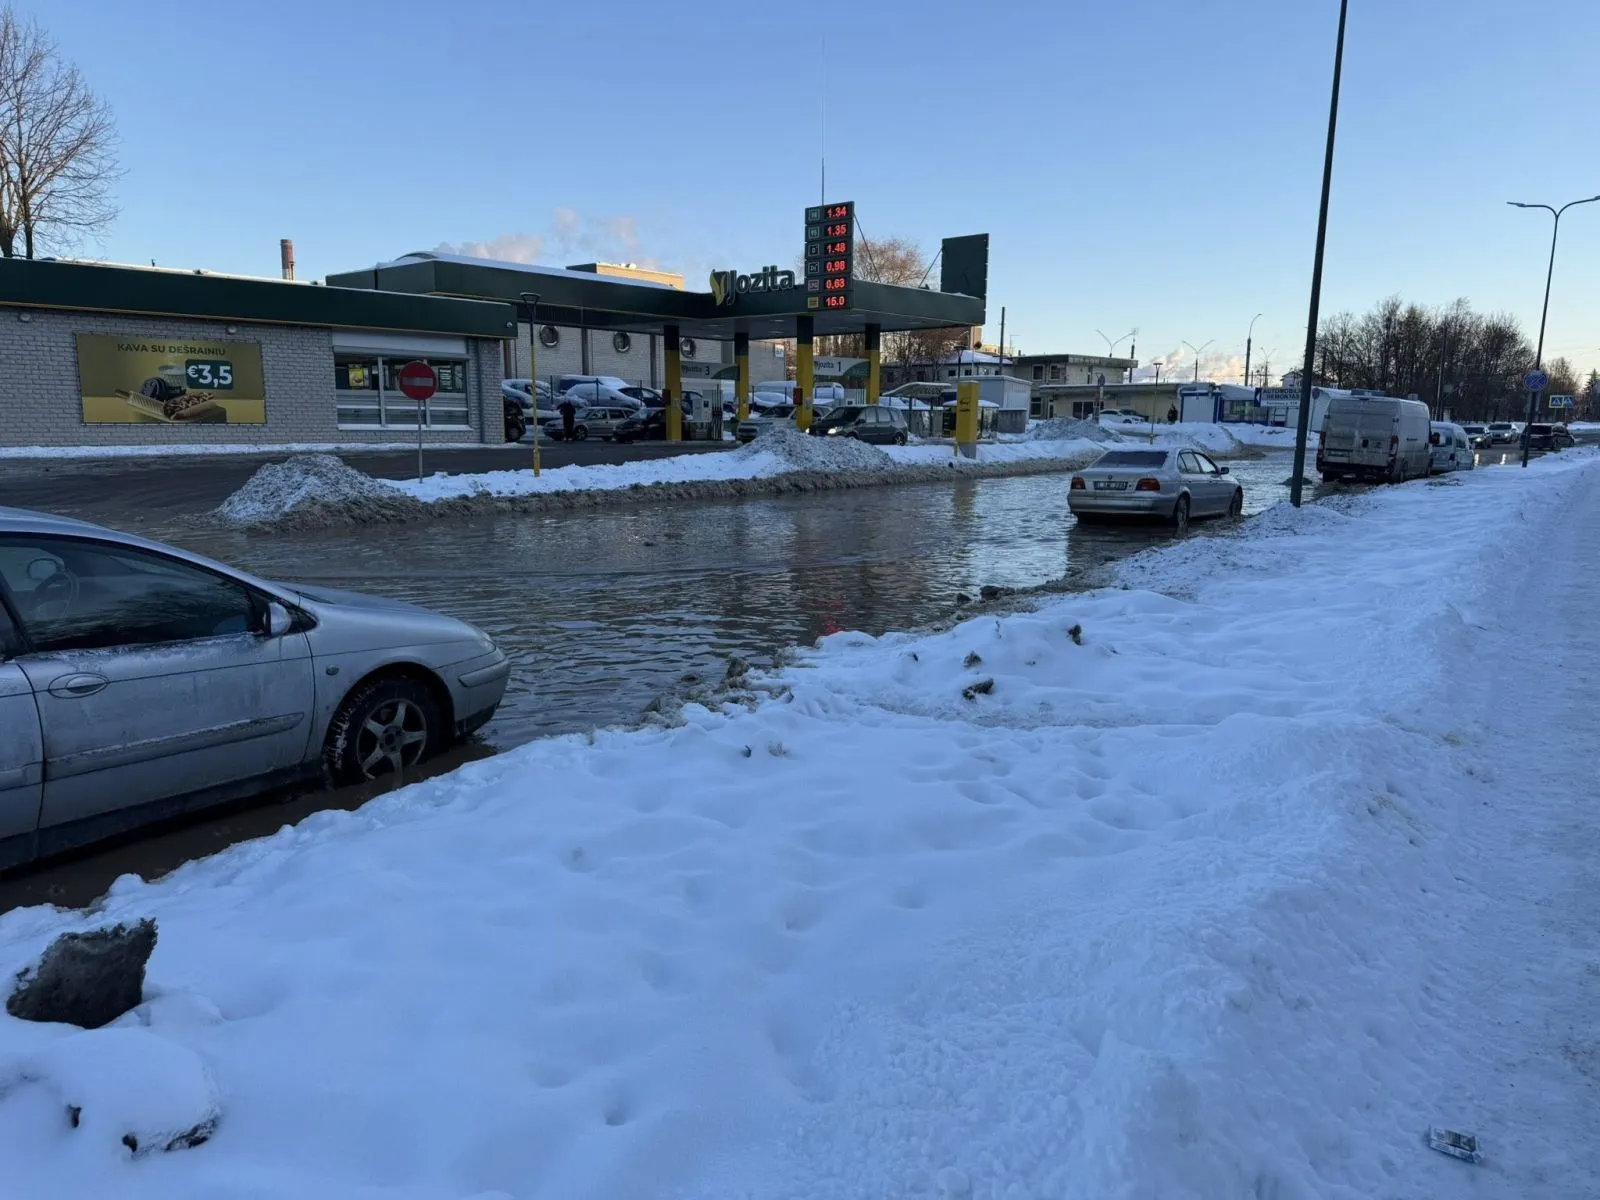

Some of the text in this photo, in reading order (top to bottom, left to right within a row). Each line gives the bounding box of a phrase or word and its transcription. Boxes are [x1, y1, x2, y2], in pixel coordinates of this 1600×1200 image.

[826, 206, 847, 218] 1.34
[826, 224, 847, 236] 1.35
[826, 242, 846, 254] 1.48
[826, 260, 846, 272] 0.98
[726, 265, 796, 306] Jozita
[825, 278, 845, 290] 0.63
[826, 296, 845, 307] 15.0
[117, 343, 226, 356] KAVA SU DEŠRAINIU
[186, 364, 233, 388] €3,5
[704, 366, 710, 375] 3
